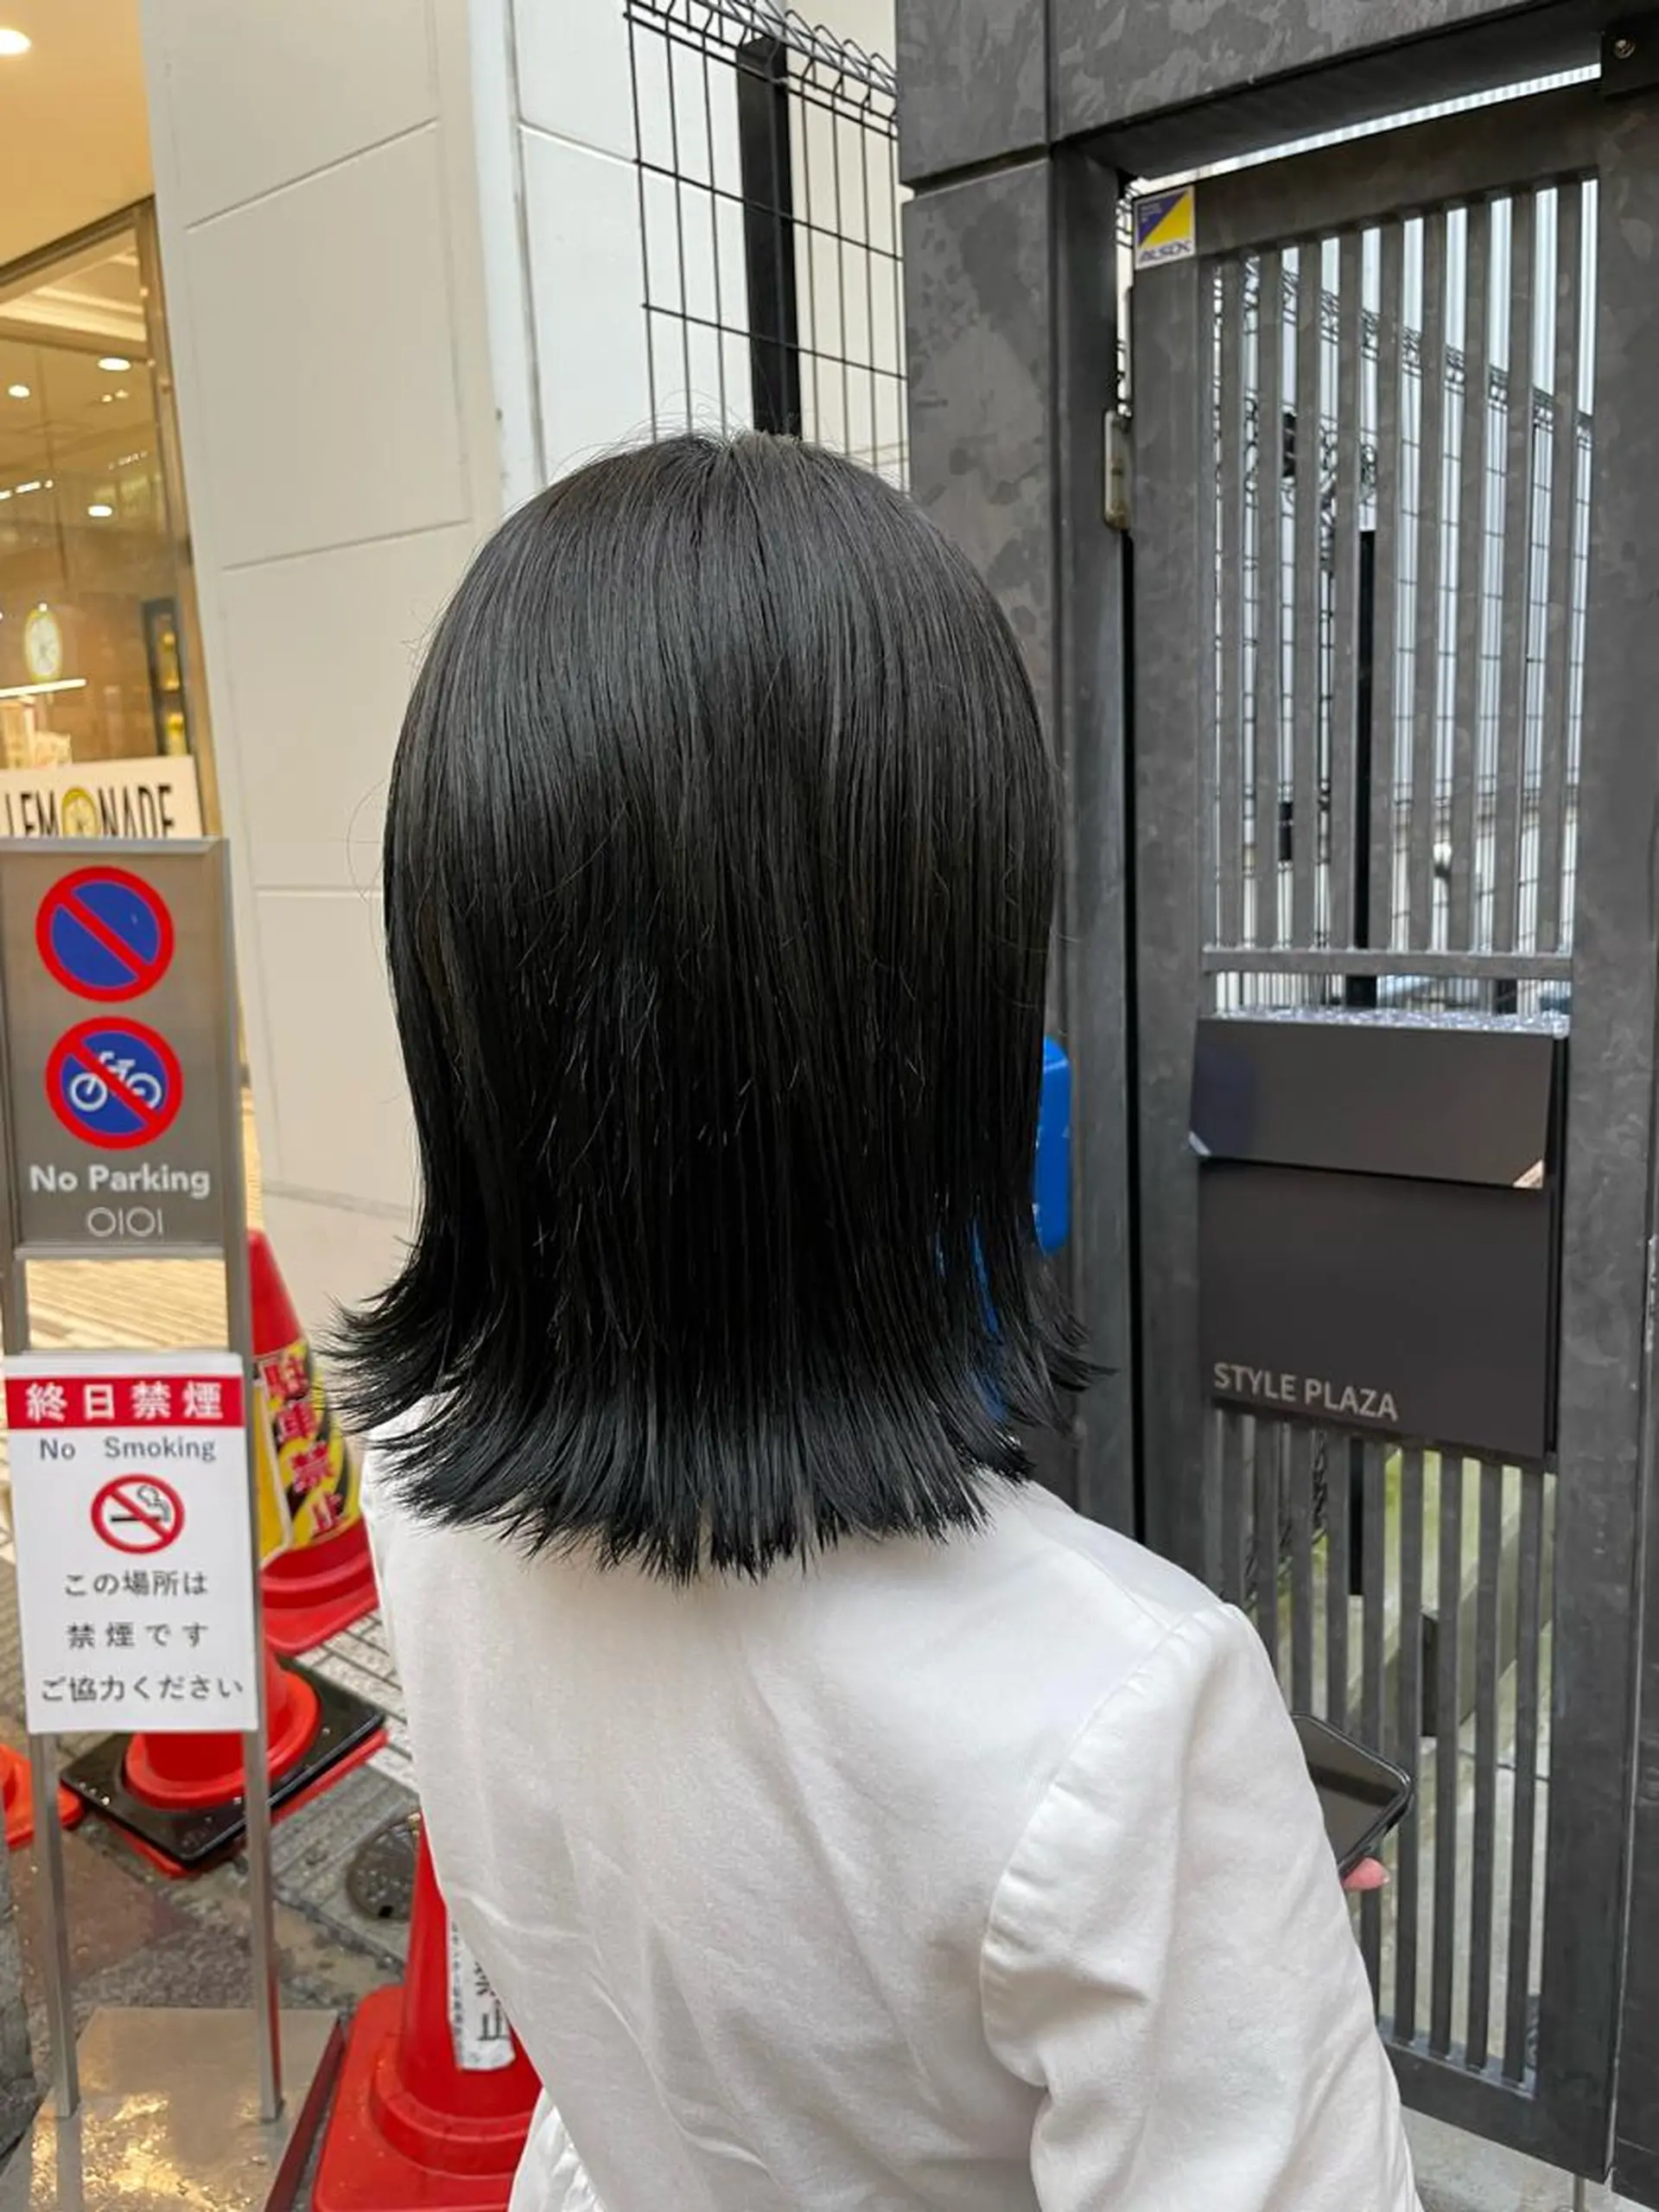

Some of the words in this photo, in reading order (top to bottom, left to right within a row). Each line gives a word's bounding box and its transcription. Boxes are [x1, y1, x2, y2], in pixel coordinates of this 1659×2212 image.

[30, 1165, 77, 1192] No
[89, 1164, 212, 1198] Parking
[25, 1381, 225, 1422] 終日禁煙
[1214, 1362, 1297, 1402] STYLE
[1305, 1377, 1399, 1422] PLAZA
[40, 1439, 76, 1461] No
[104, 1437, 217, 1462] Smoking
[64, 1569, 208, 1598] この場所は
[67, 1622, 209, 1649] 禁煙です
[41, 1674, 244, 1702] ご協力ください
